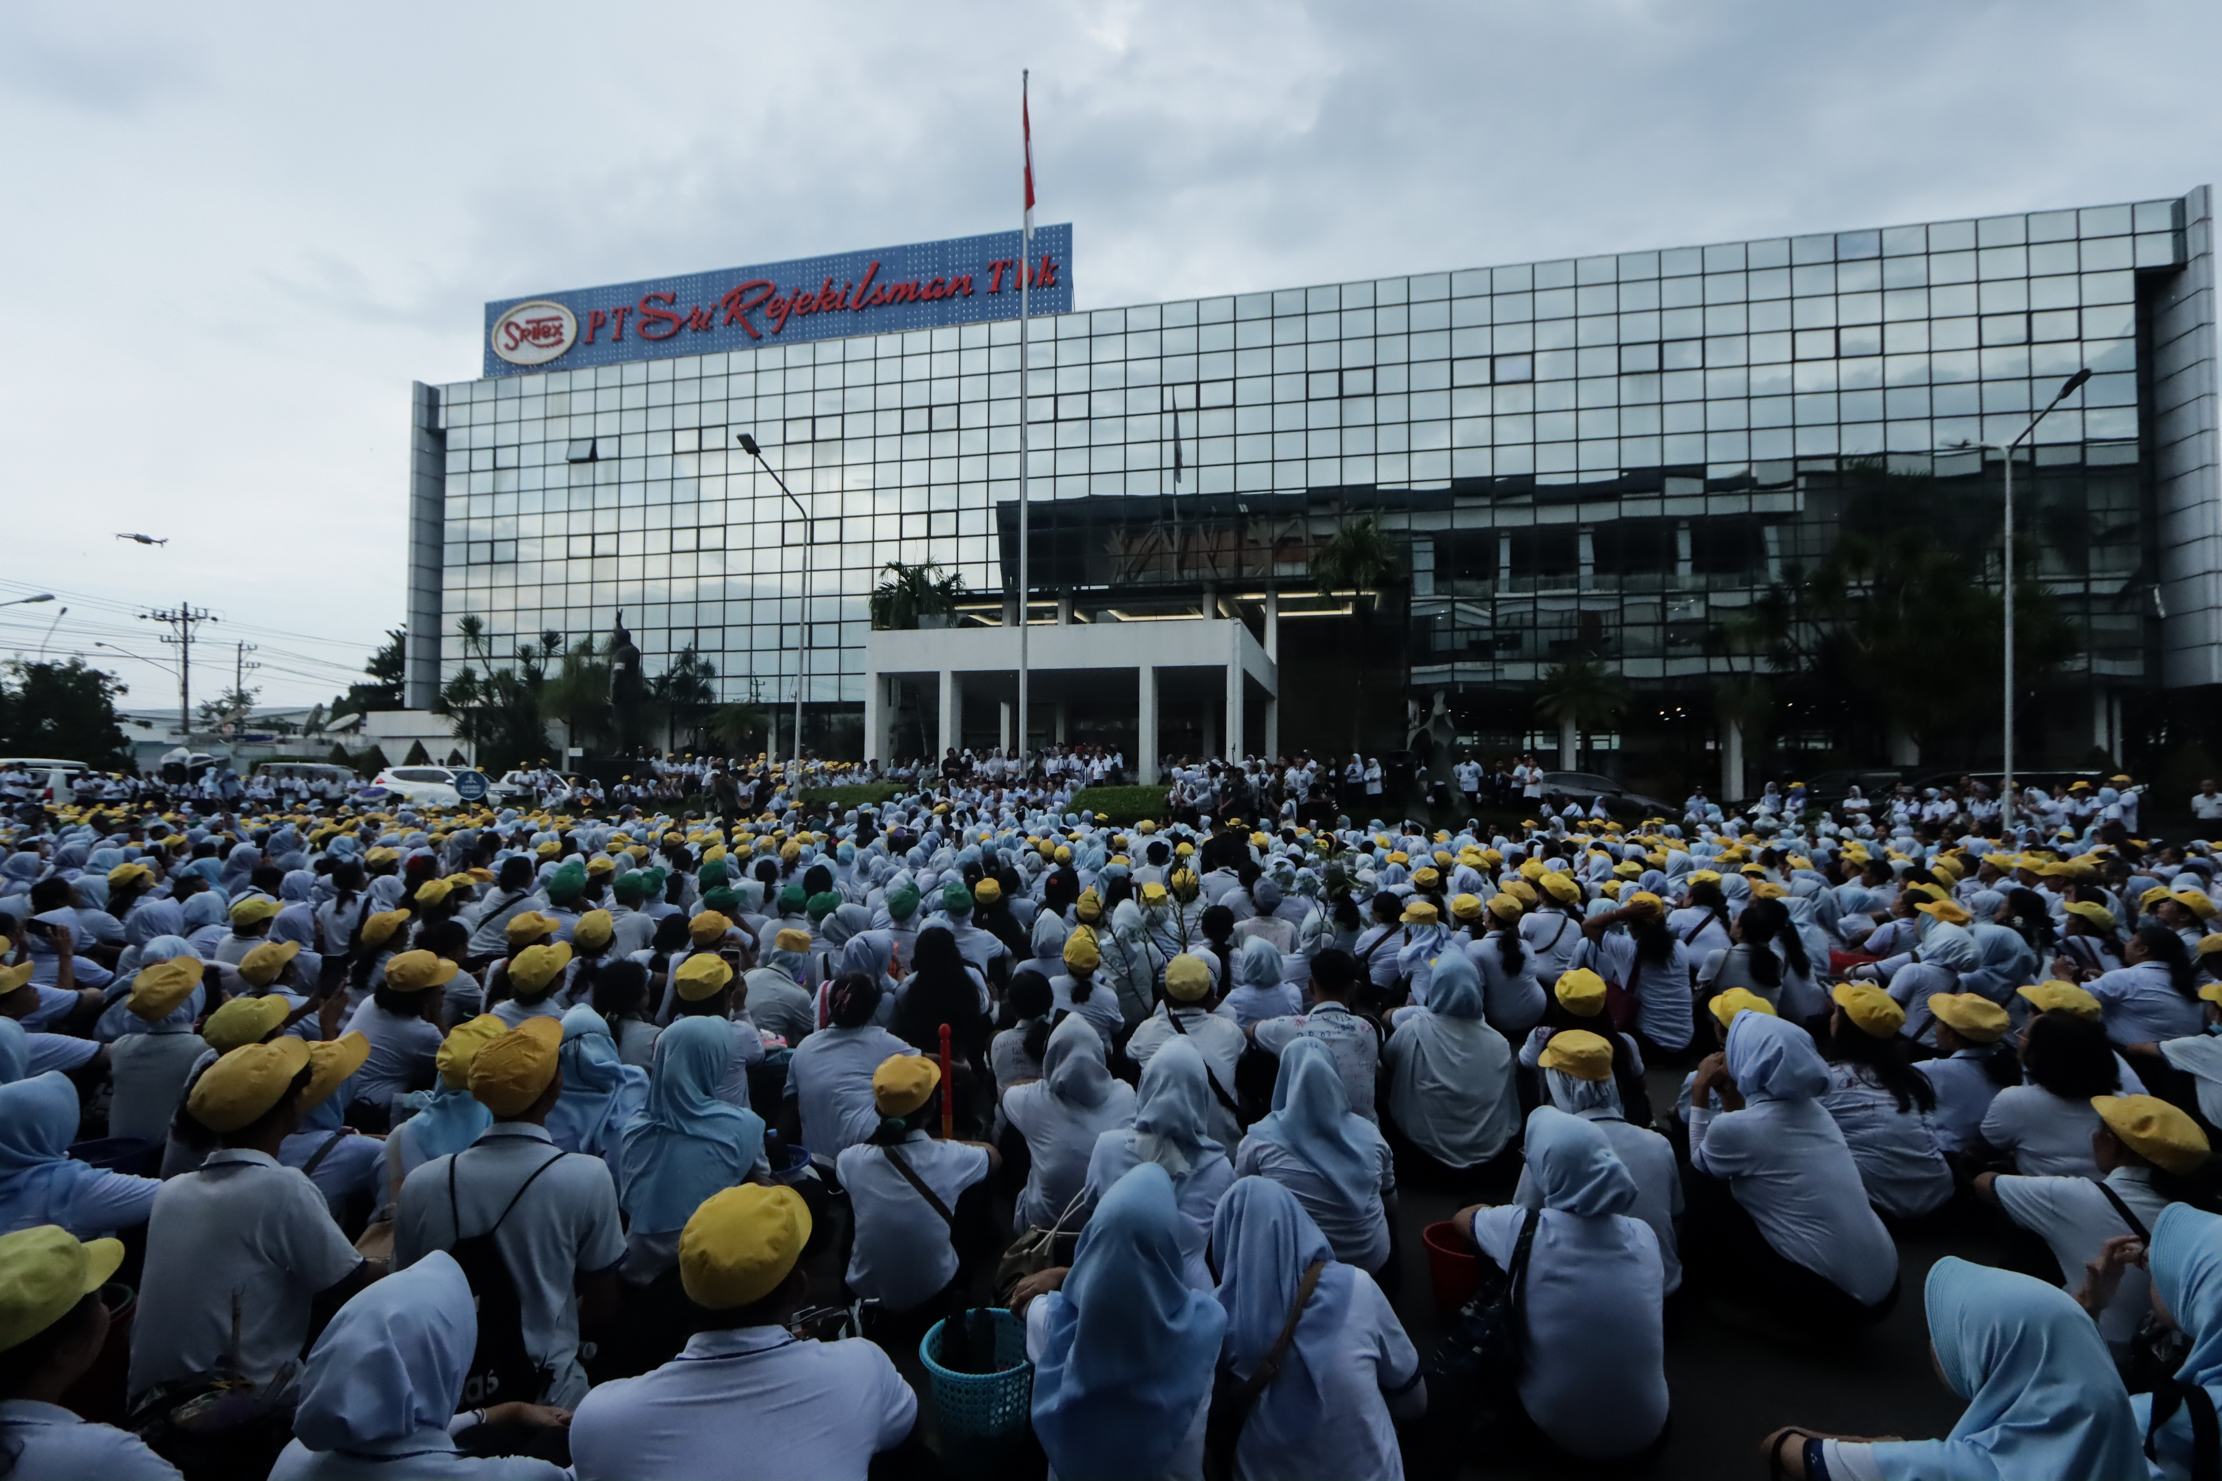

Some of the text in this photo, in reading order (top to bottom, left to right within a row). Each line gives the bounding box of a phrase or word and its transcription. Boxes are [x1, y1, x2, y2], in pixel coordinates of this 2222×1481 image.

[584, 254, 1059, 344] PT Sri Rejeki Isman Tbk
